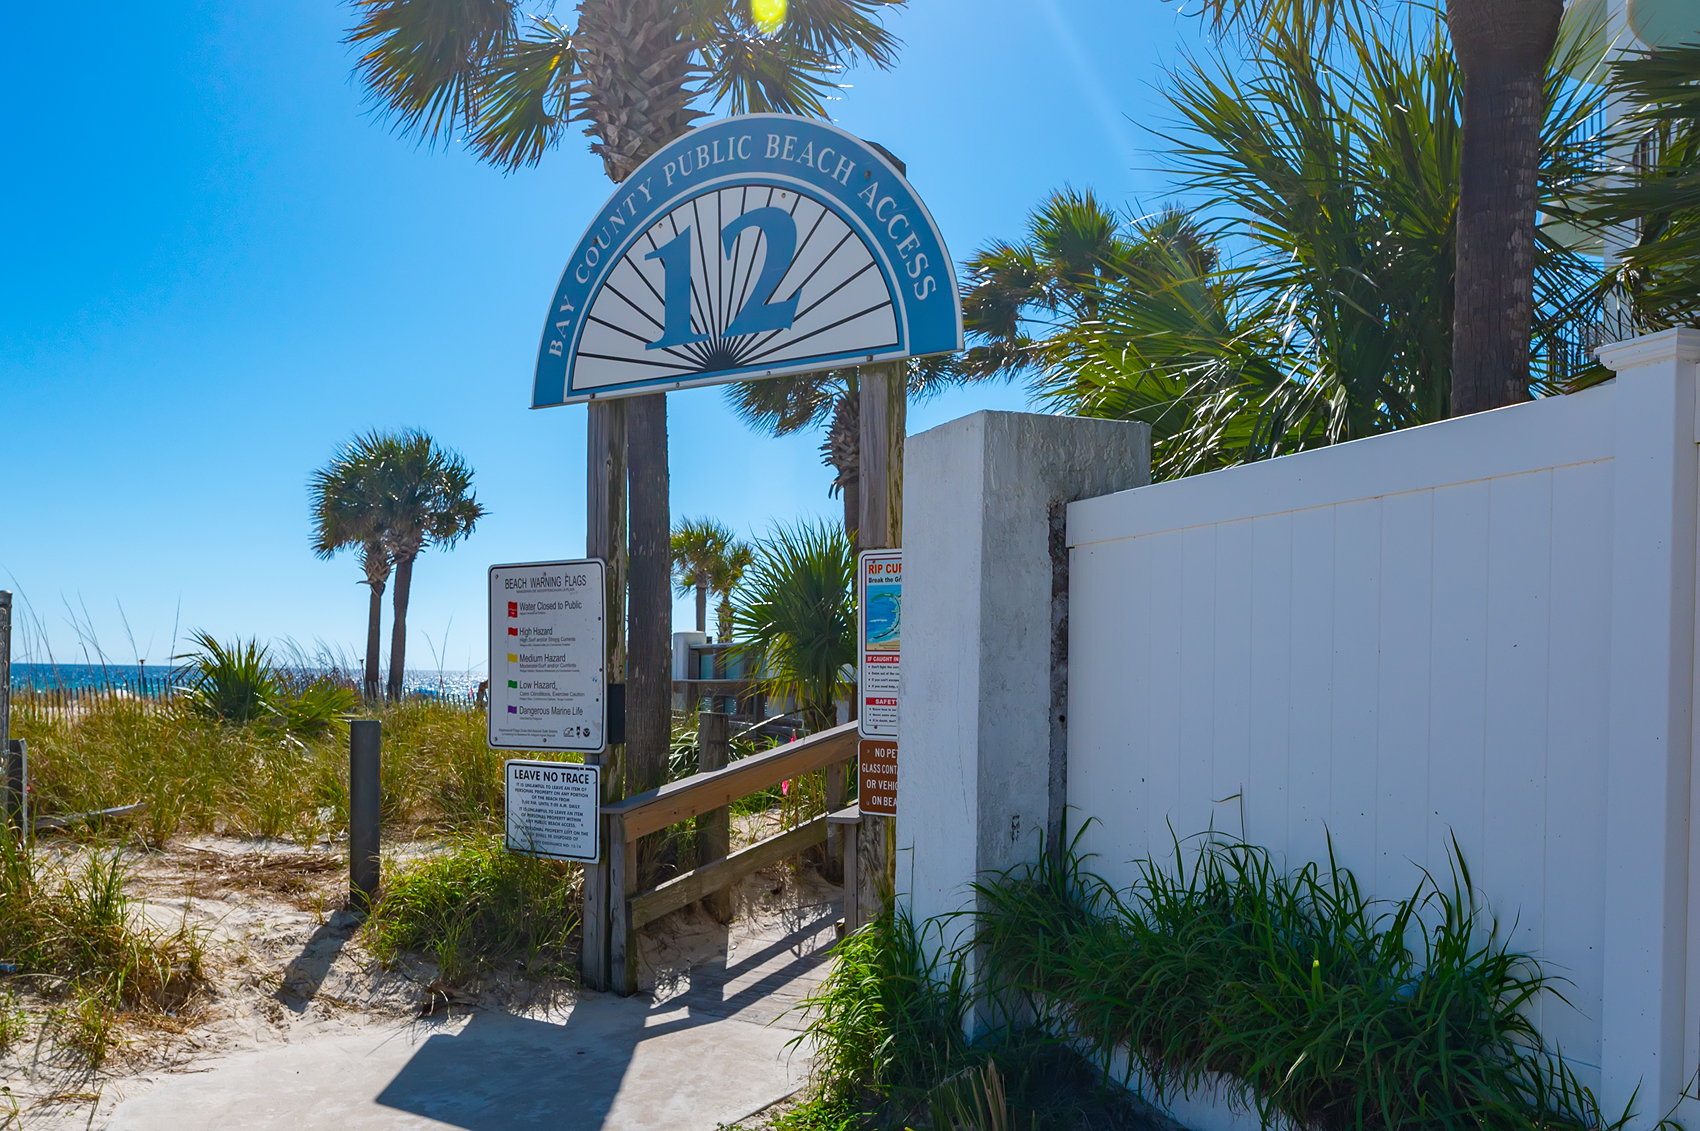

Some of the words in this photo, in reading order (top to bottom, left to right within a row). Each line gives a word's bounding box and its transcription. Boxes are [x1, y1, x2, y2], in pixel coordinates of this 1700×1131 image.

[548, 294, 576, 358] BAY
[575, 177, 653, 284] COUNTY
[663, 135, 752, 187] PUBLIC
[764, 134, 856, 187] BEACH
[857, 181, 937, 301] ACCESS
[644, 206, 802, 351] 12
[868, 563, 883, 574] RIP
[504, 578, 527, 589] BEACH
[530, 576, 562, 588] WARNING
[564, 574, 587, 586] FLAGS
[520, 602, 536, 611] Water
[537, 601, 556, 610] Closed
[557, 602, 564, 610] to
[564, 600, 582, 609] Public
[520, 627, 532, 638] High
[533, 626, 553, 636] Hazard
[520, 654, 543, 662] Medium
[544, 654, 566, 662] Hazard
[520, 680, 532, 689] Low
[519, 706, 550, 716] Dangerous
[551, 706, 571, 715] Marine
[572, 706, 583, 716] Life
[875, 748, 885, 758] NO
[862, 763, 880, 773] GLASS
[882, 765, 898, 774] CONT
[515, 769, 540, 780] LEAVE
[544, 771, 558, 782] NO
[561, 773, 589, 784] TRACE
[866, 779, 876, 789] OR
[872, 796, 882, 806] ON
